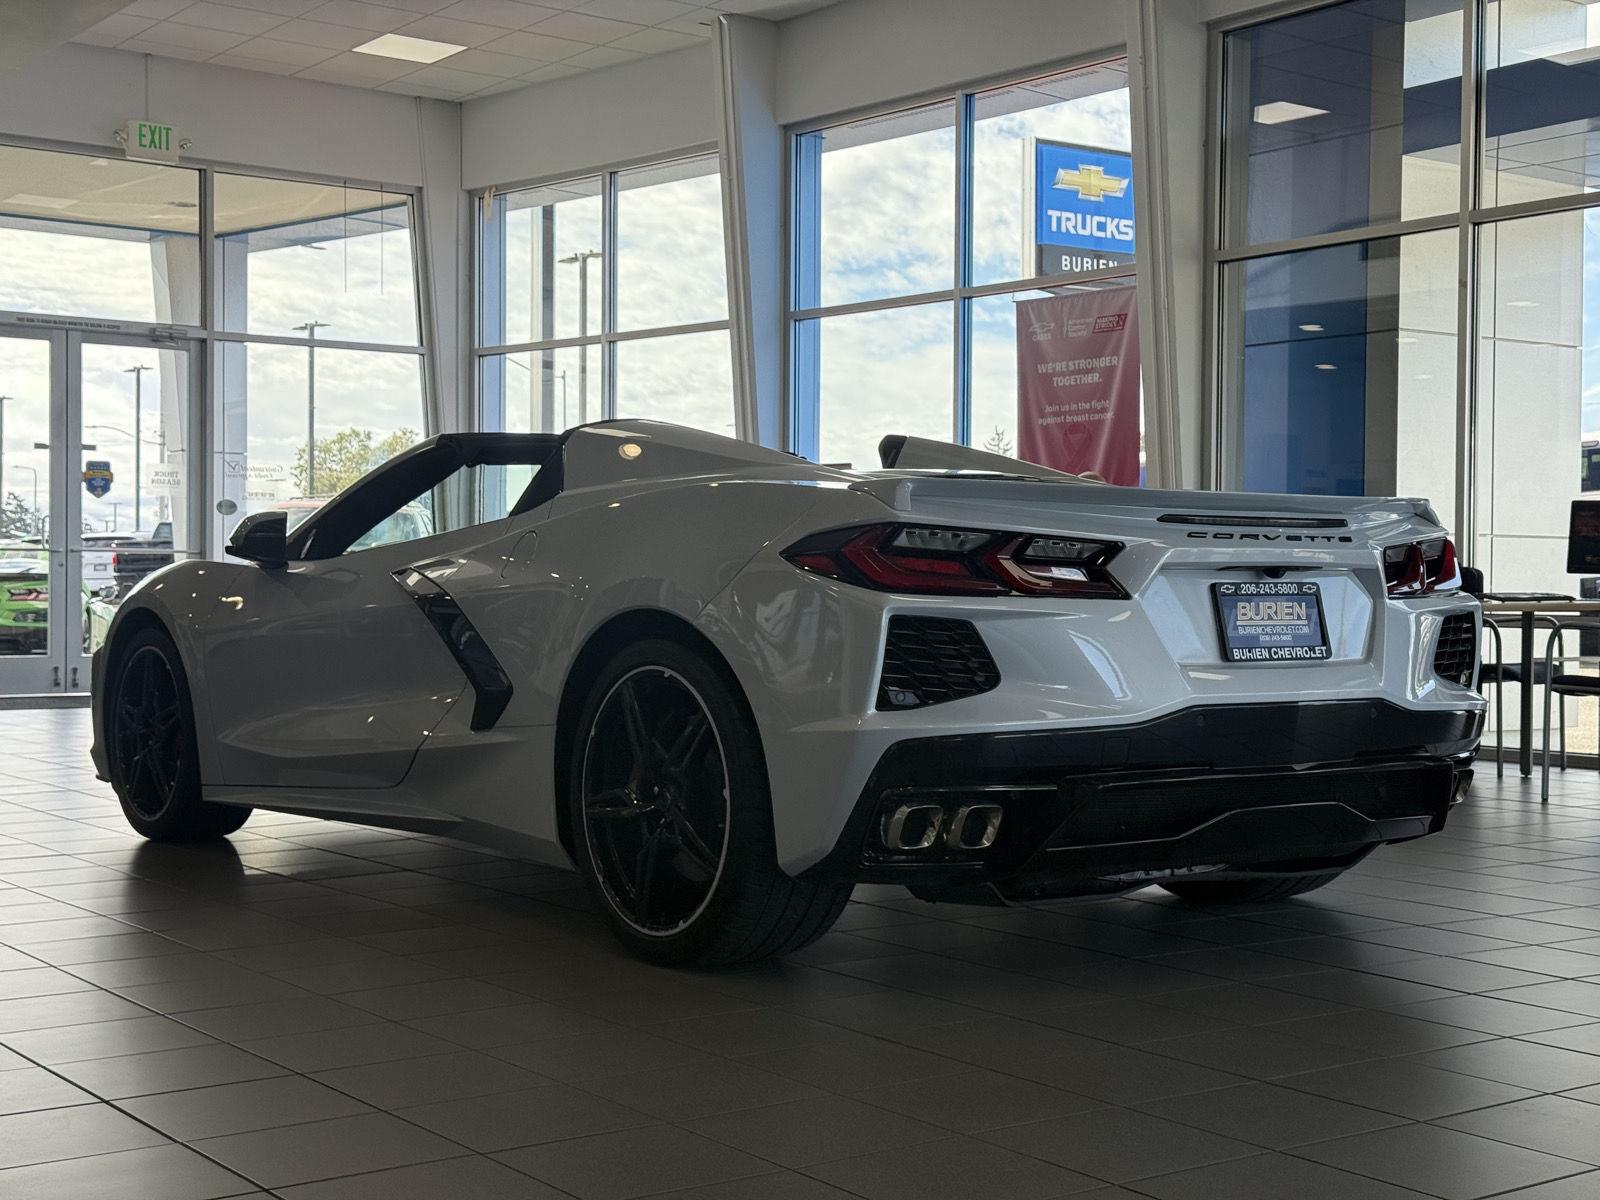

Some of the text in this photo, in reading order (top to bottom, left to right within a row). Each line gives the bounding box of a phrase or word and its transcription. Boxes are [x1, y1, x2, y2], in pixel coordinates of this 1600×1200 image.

[138, 123, 172, 151] EXIT
[1047, 209, 1134, 241] TRUCKS
[1037, 356, 1119, 374] WE'RE STRONGER
[1052, 372, 1103, 387] TOGETHER.
[1045, 399, 1110, 413] Join us in the fight
[1038, 414, 1064, 426] against
[1065, 413, 1089, 423] breast
[1187, 531, 1353, 543] CORVETTE
[1240, 583, 1298, 594] 206-243-5800
[1237, 602, 1306, 620] BURIEN
[1238, 625, 1310, 634] BURIENCHEVROLET.COM
[1233, 646, 1327, 660] BURIEN CHEVROLET
